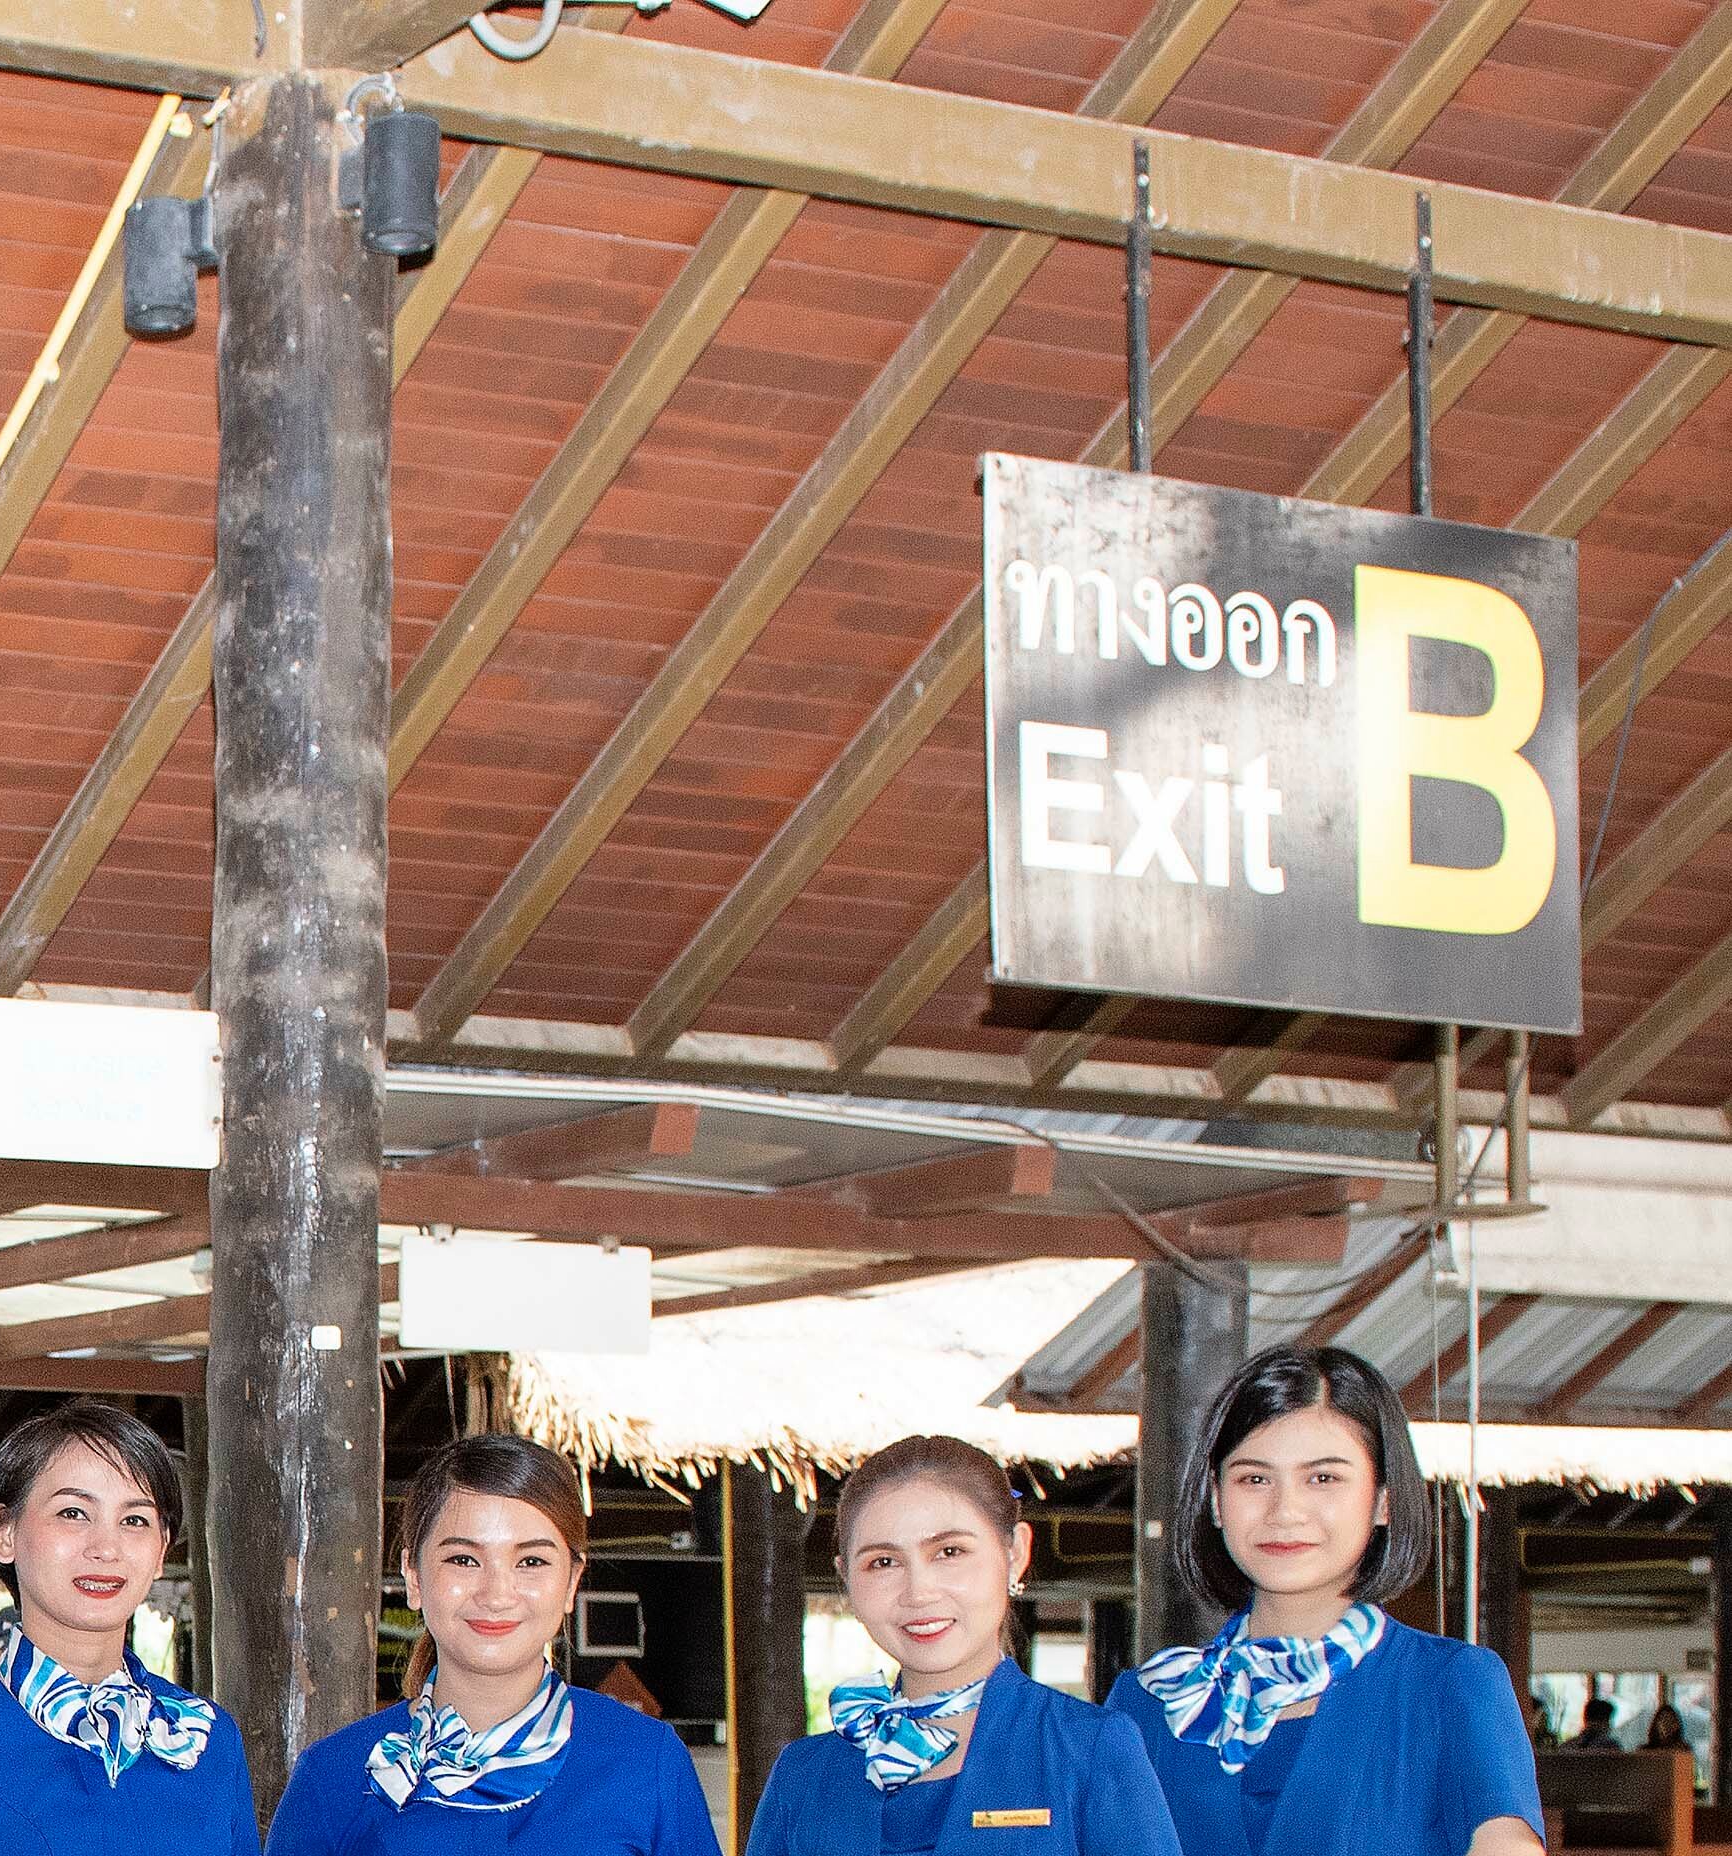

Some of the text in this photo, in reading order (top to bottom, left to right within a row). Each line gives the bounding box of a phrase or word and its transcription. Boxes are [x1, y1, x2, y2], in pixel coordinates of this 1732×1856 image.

[1005, 558, 1337, 688] ทางออก
[1018, 721, 1285, 895] Exit
[1355, 564, 1557, 935] B
